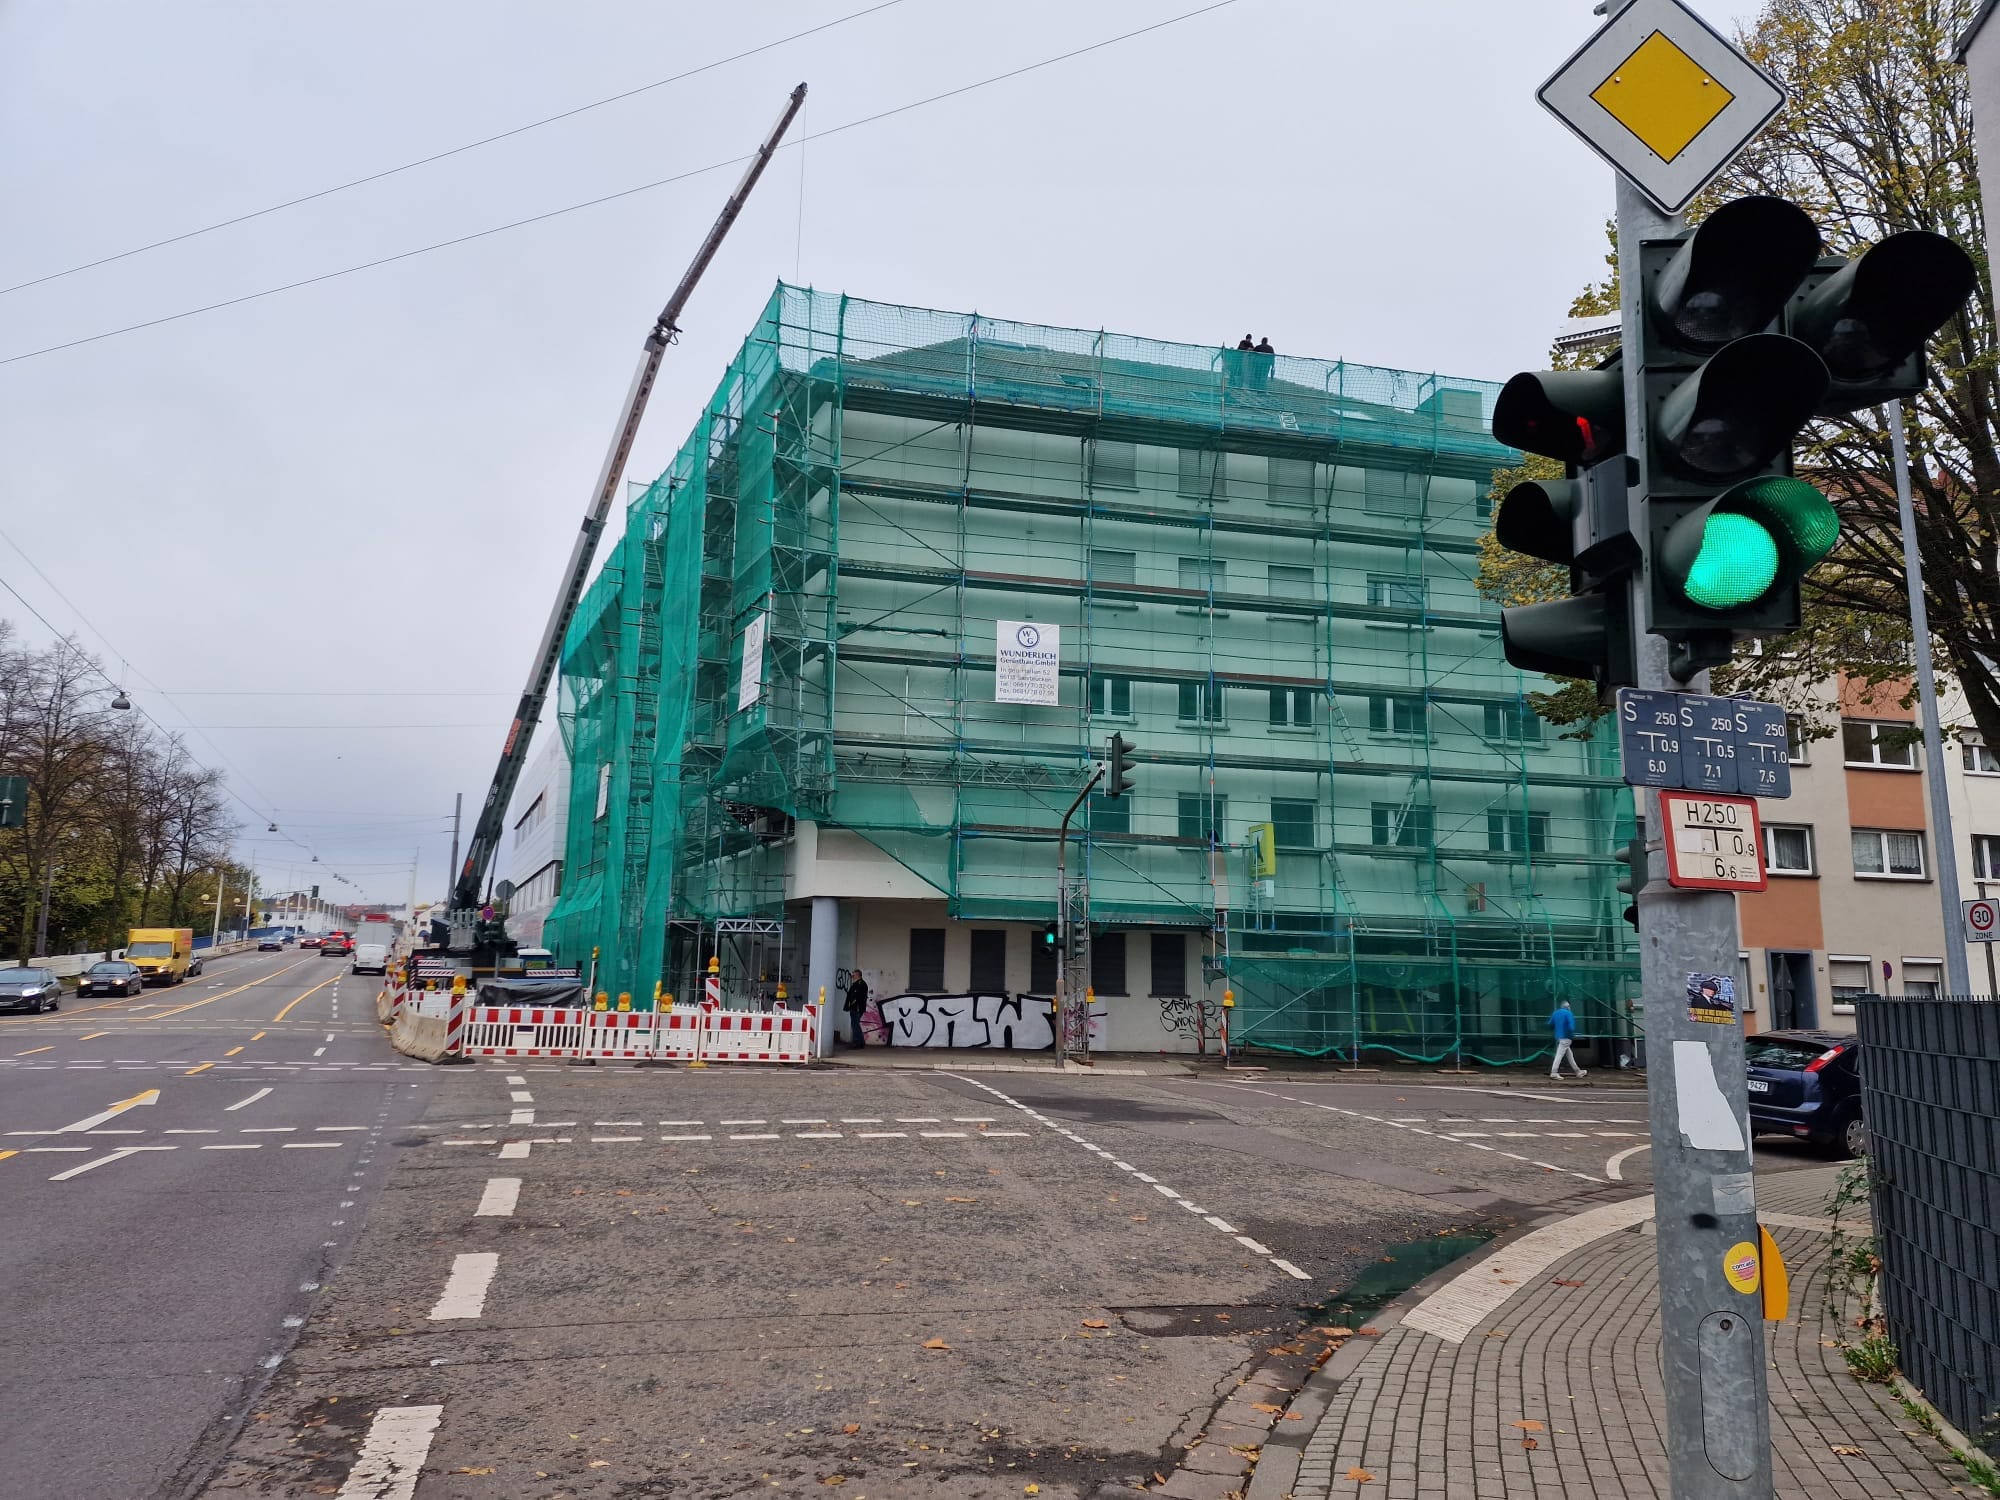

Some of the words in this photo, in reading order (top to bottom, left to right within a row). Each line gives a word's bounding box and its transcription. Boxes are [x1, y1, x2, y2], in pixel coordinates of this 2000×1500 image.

[1000, 650, 1056, 659] WUNDERLICH
[1624, 701, 1637, 721] S
[1655, 712, 1677, 726] 250
[1680, 707, 1694, 727] S
[1711, 717, 1732, 731] 250
[1735, 713, 1748, 733] S
[1764, 723, 1785, 737] 250
[1974, 910, 1989, 923] 30
